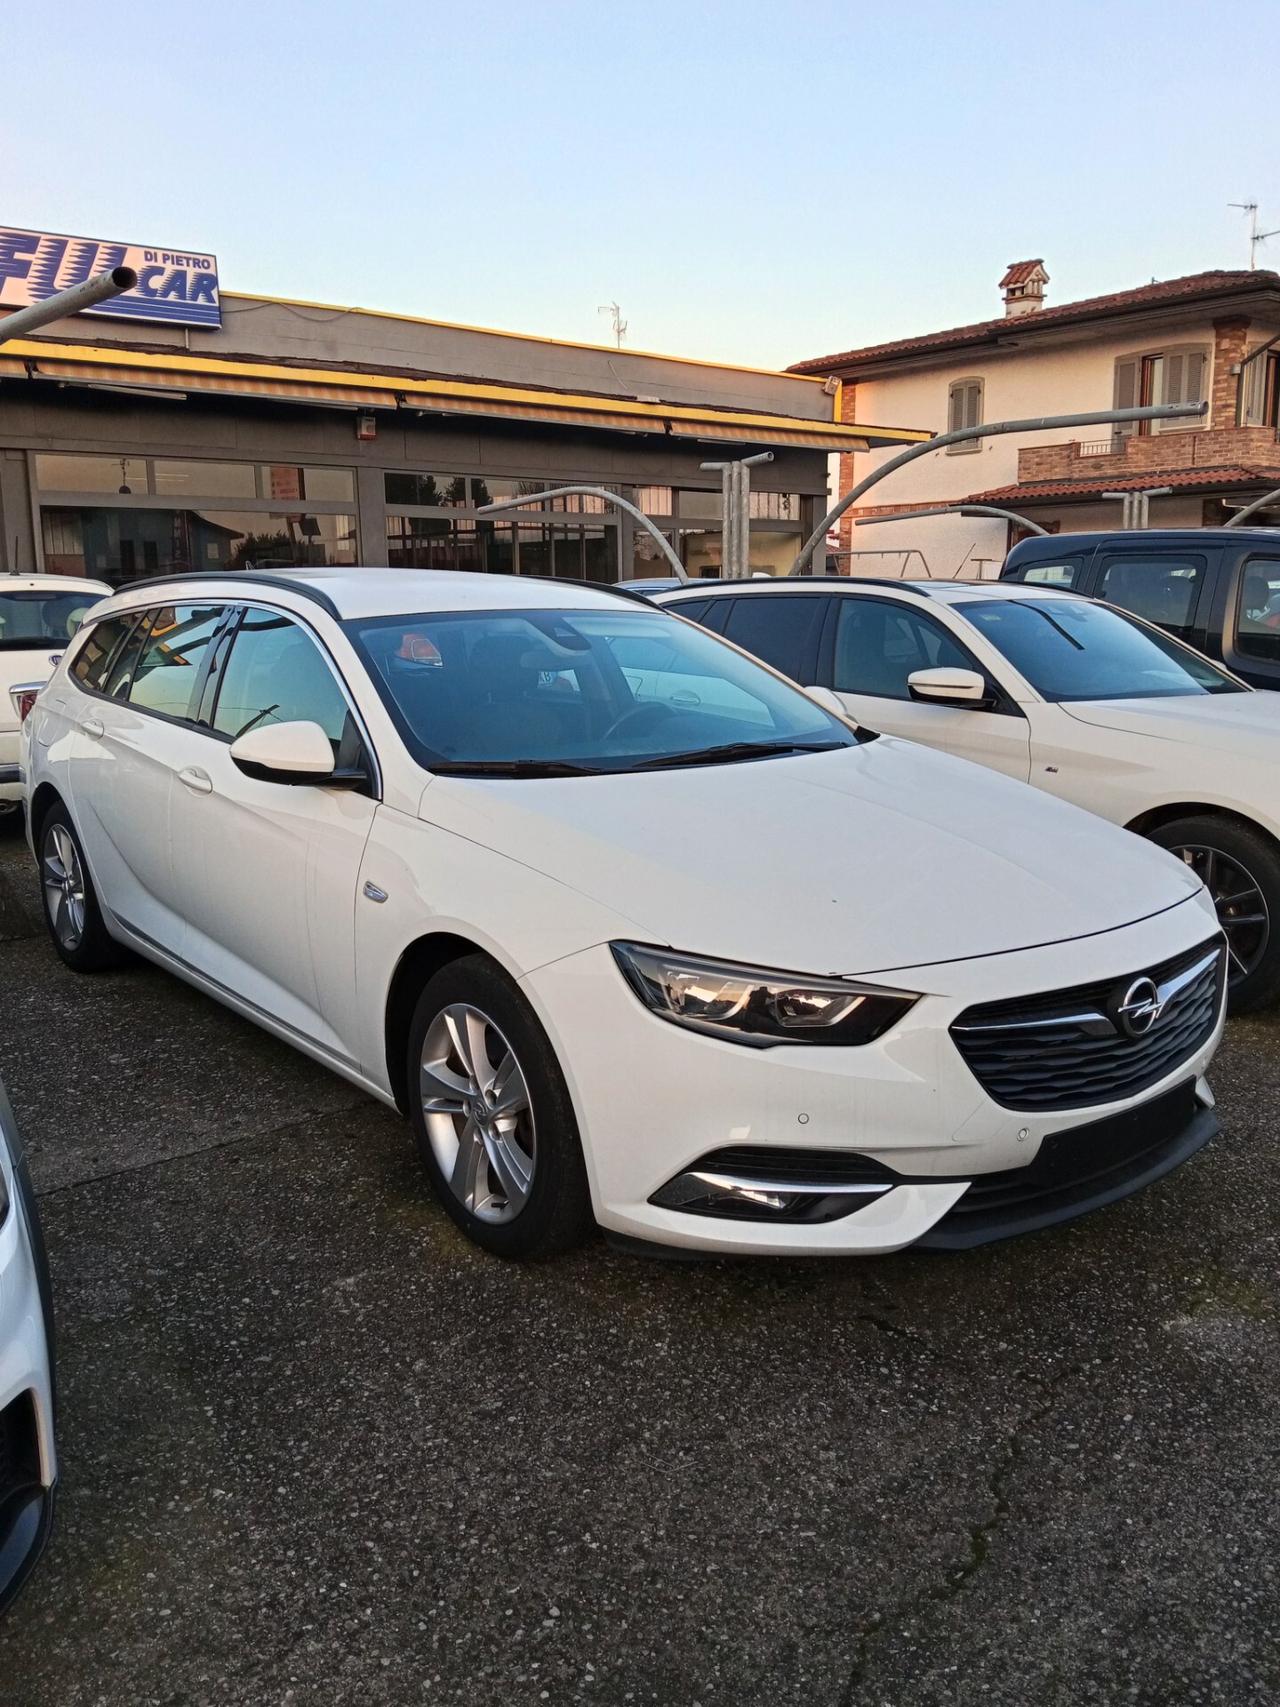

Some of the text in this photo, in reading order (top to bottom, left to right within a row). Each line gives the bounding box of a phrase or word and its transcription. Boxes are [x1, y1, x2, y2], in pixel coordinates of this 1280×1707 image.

[144, 250, 211, 270] DI PIETRO
[135, 265, 217, 304] CAR
